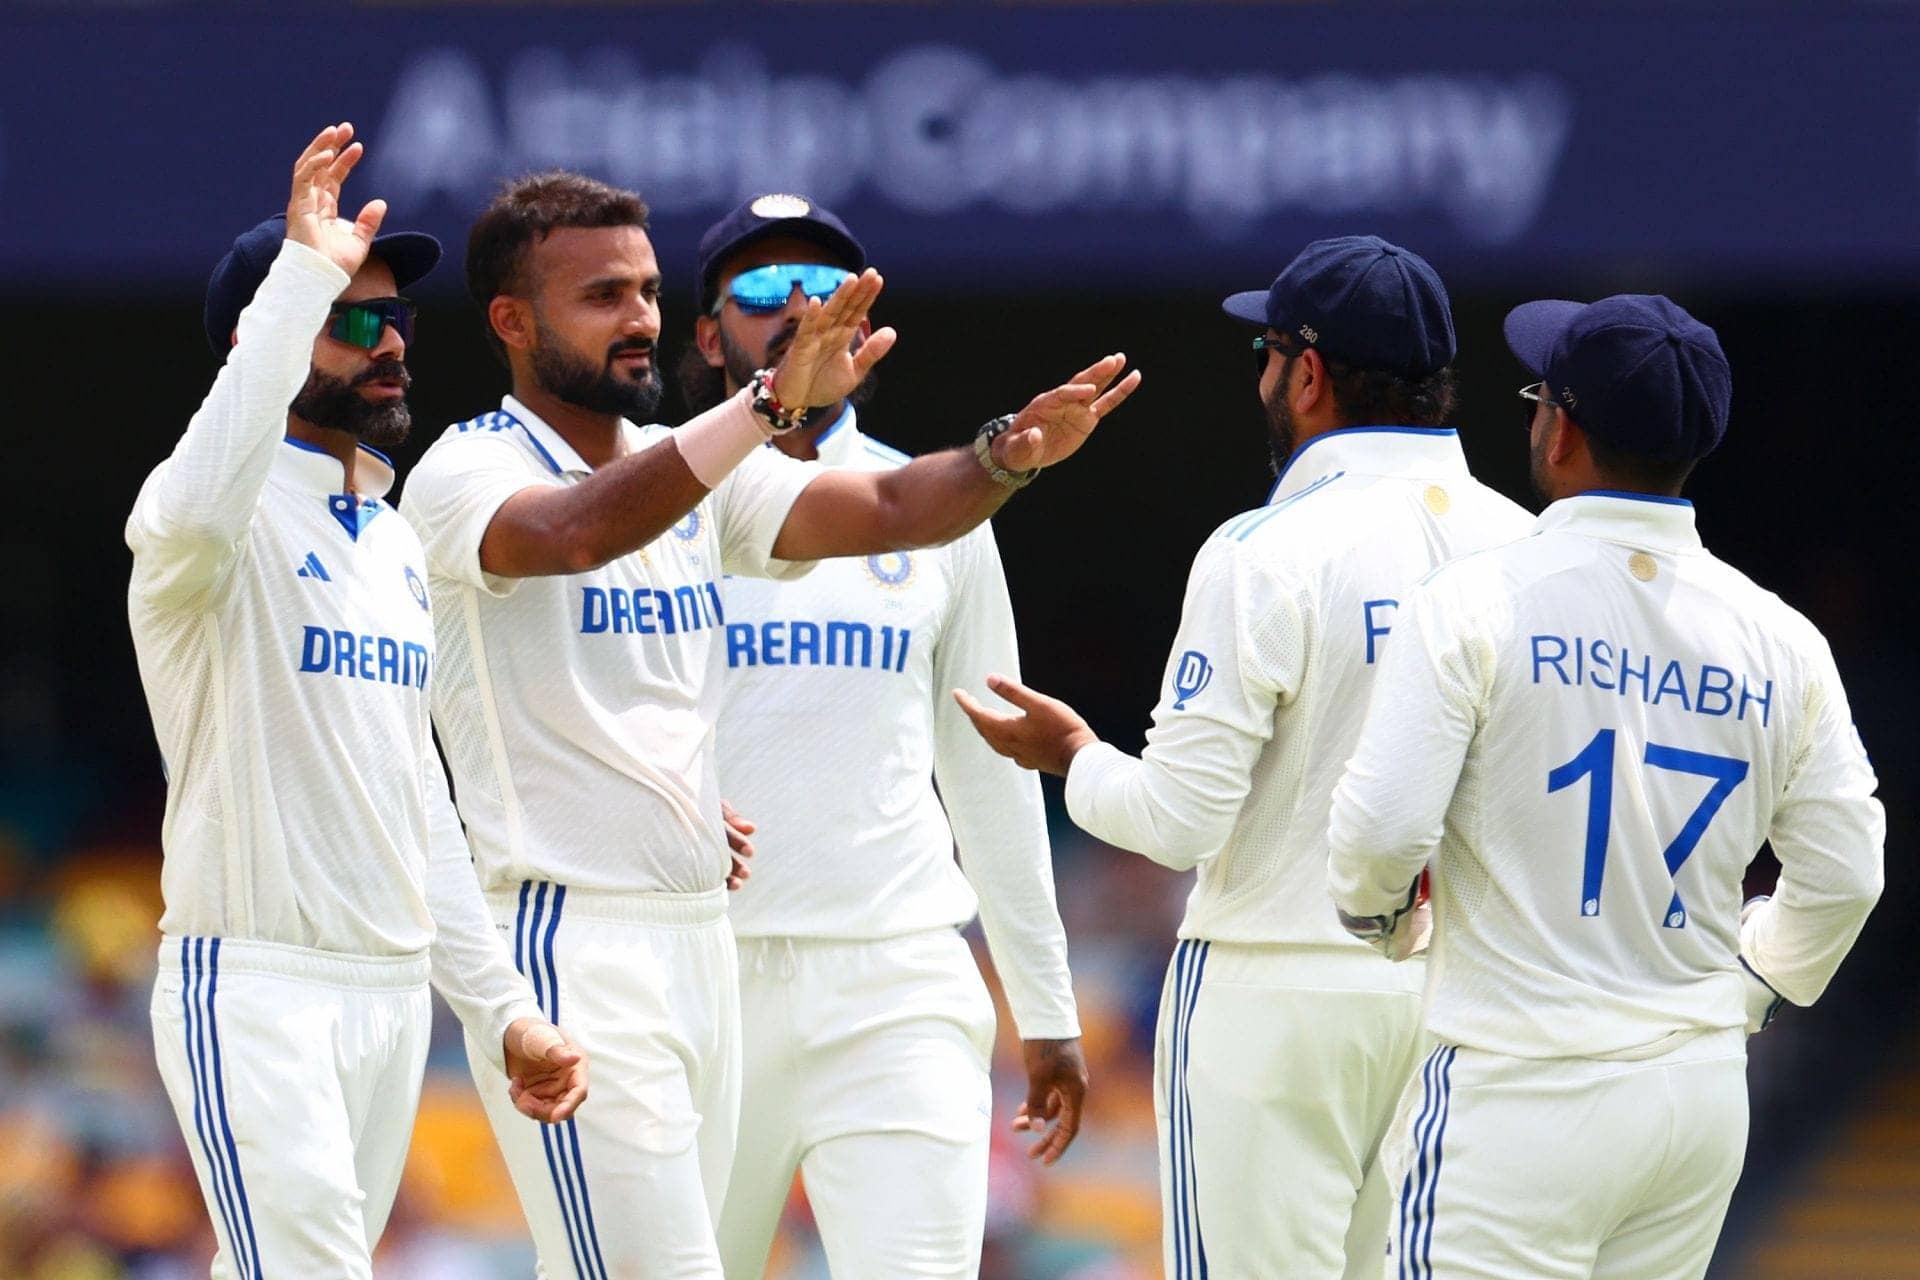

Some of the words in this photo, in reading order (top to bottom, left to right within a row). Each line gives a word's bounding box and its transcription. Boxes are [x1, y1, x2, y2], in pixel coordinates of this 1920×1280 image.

[376, 46, 505, 204] A
[862, 44, 1570, 238] Company
[1299, 324, 1318, 344] 280
[300, 625, 429, 691] DREAM
[725, 621, 910, 673] REAM11
[1531, 635, 1773, 728] RISHABH
[1548, 728, 1750, 929] 17
